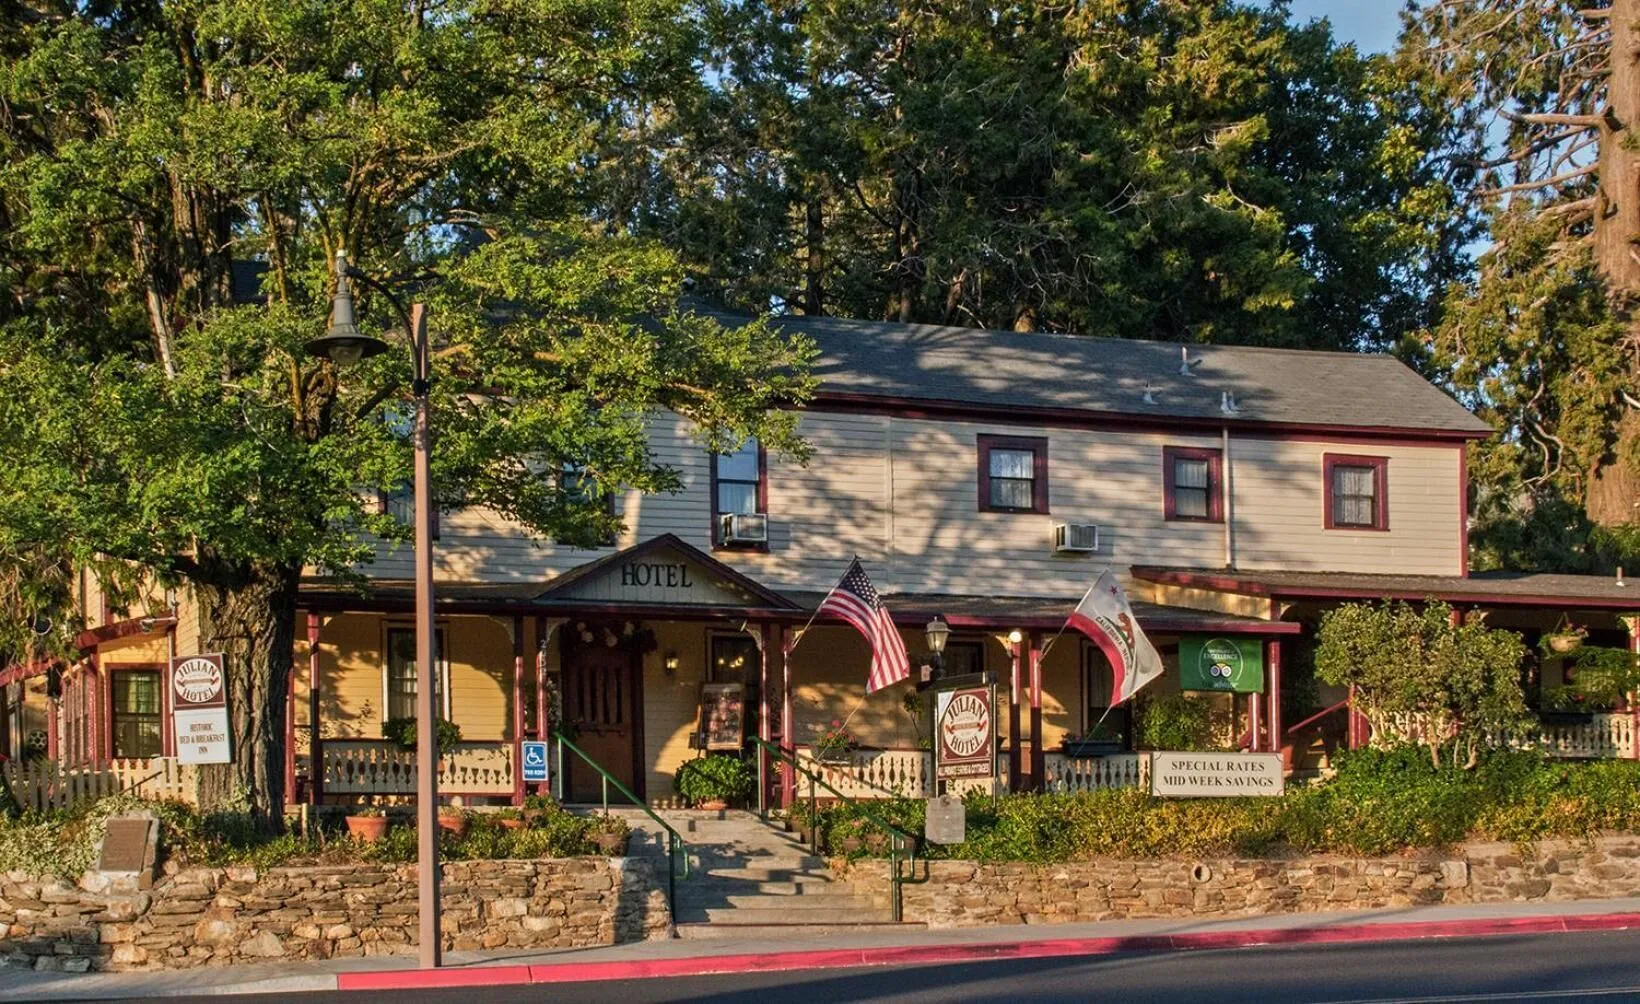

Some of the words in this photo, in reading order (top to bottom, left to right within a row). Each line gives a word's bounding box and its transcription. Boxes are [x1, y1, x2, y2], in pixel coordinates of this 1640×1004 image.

[621, 562, 693, 588] HOTEL
[178, 660, 219, 678] JULIAN
[182, 687, 217, 701] HOTEL
[947, 696, 986, 723] JULIAN
[950, 735, 983, 754] HOTEL
[1171, 761, 1223, 771] SPECIAL
[1227, 762, 1265, 771] RATES
[1163, 775, 1185, 786] MID
[1189, 775, 1222, 786] WEEK
[1225, 776, 1274, 787] SAVINGS
